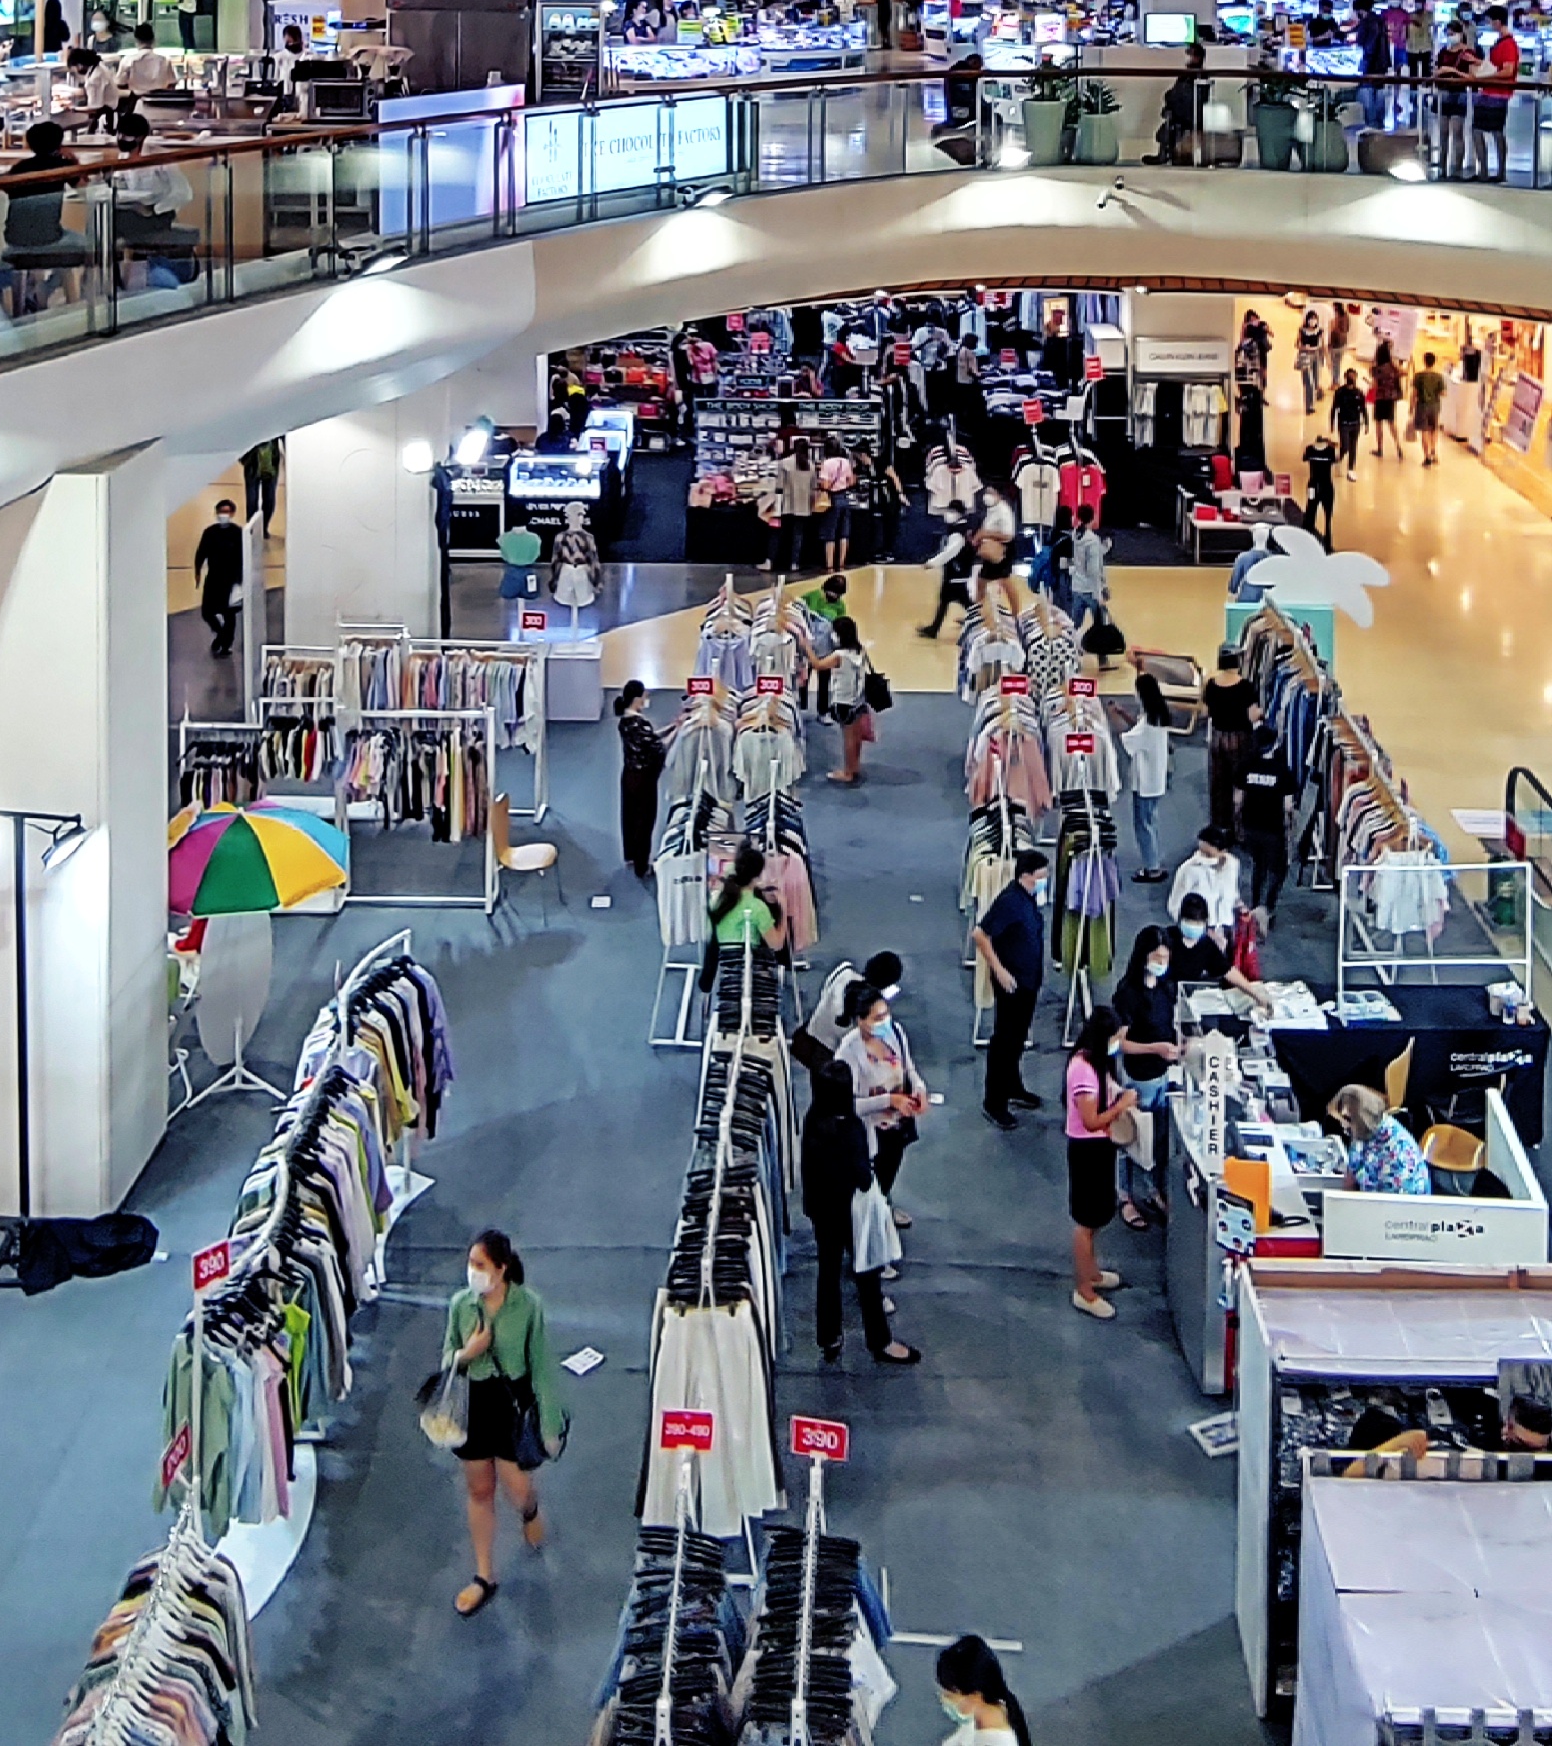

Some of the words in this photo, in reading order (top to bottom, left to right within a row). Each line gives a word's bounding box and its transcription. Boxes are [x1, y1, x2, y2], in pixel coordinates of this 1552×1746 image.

[1208, 1055, 1220, 1155] CASHIER
[199, 1251, 225, 1279] 390
[802, 1427, 839, 1450] 390
